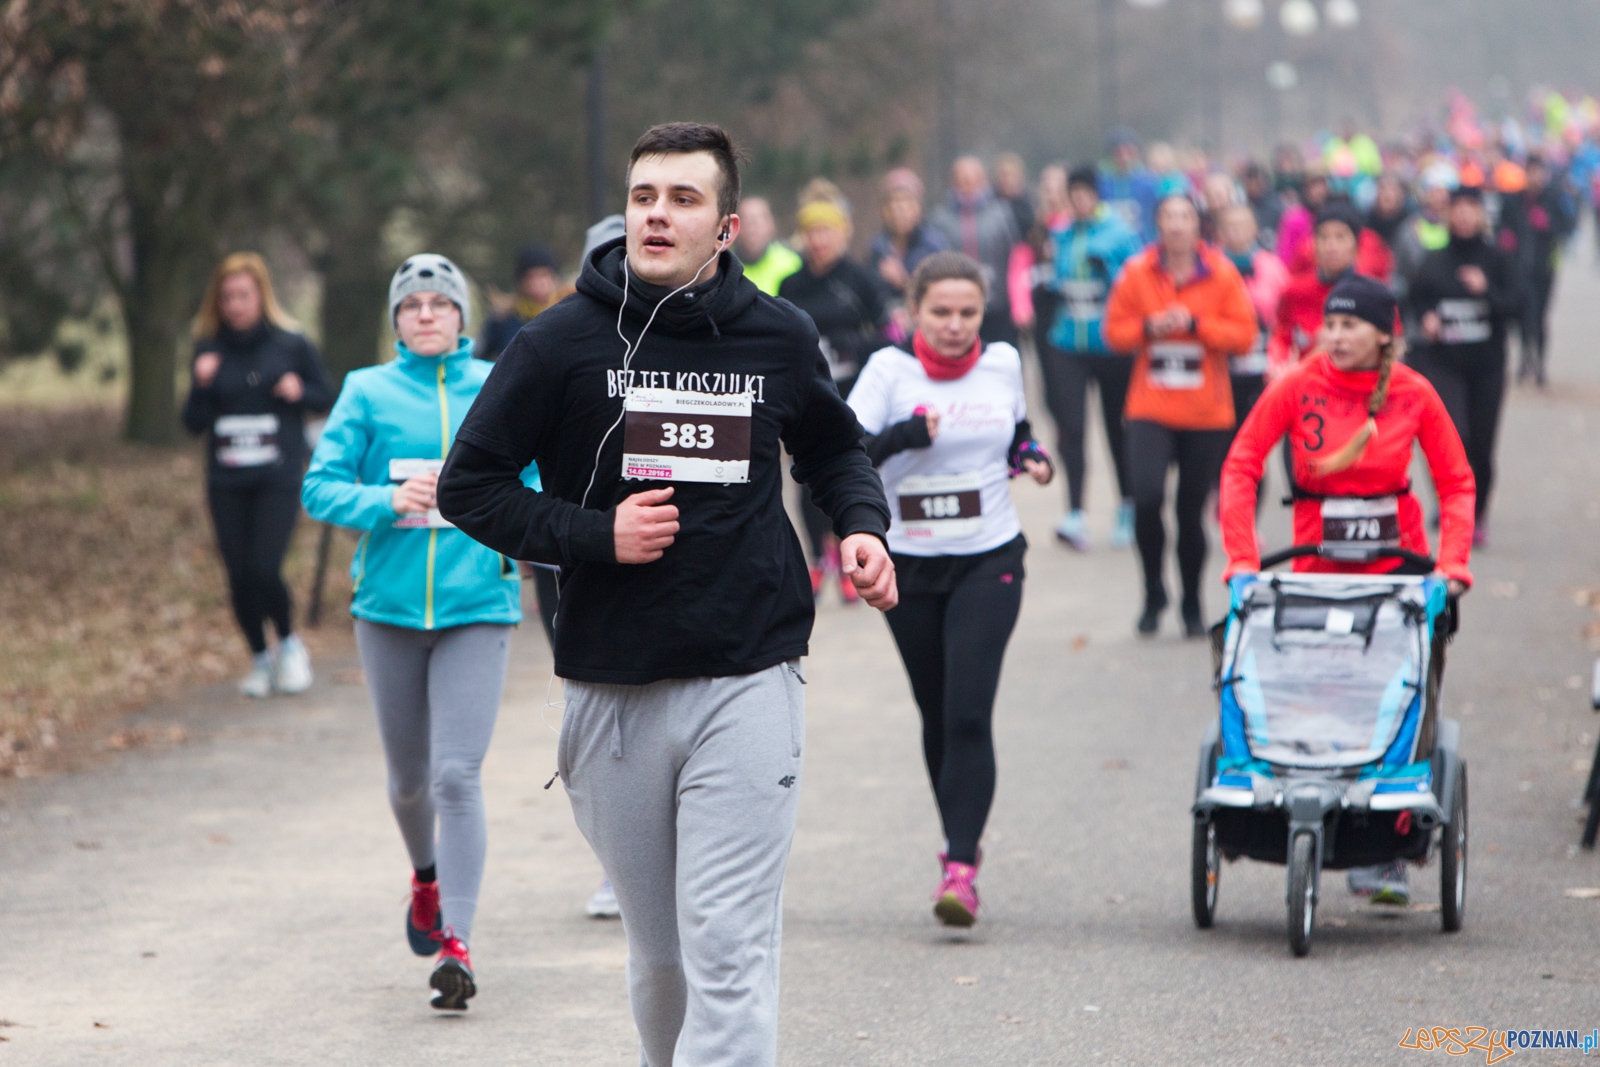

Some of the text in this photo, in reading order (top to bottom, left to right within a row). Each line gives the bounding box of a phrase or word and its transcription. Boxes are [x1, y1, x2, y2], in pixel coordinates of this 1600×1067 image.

[607, 369, 636, 398] BEZ
[676, 399, 746, 408] BIEGCZEKOLADOWY.PL
[660, 422, 714, 449] 383
[1302, 412, 1325, 452] 3
[778, 775, 796, 788] 4F
